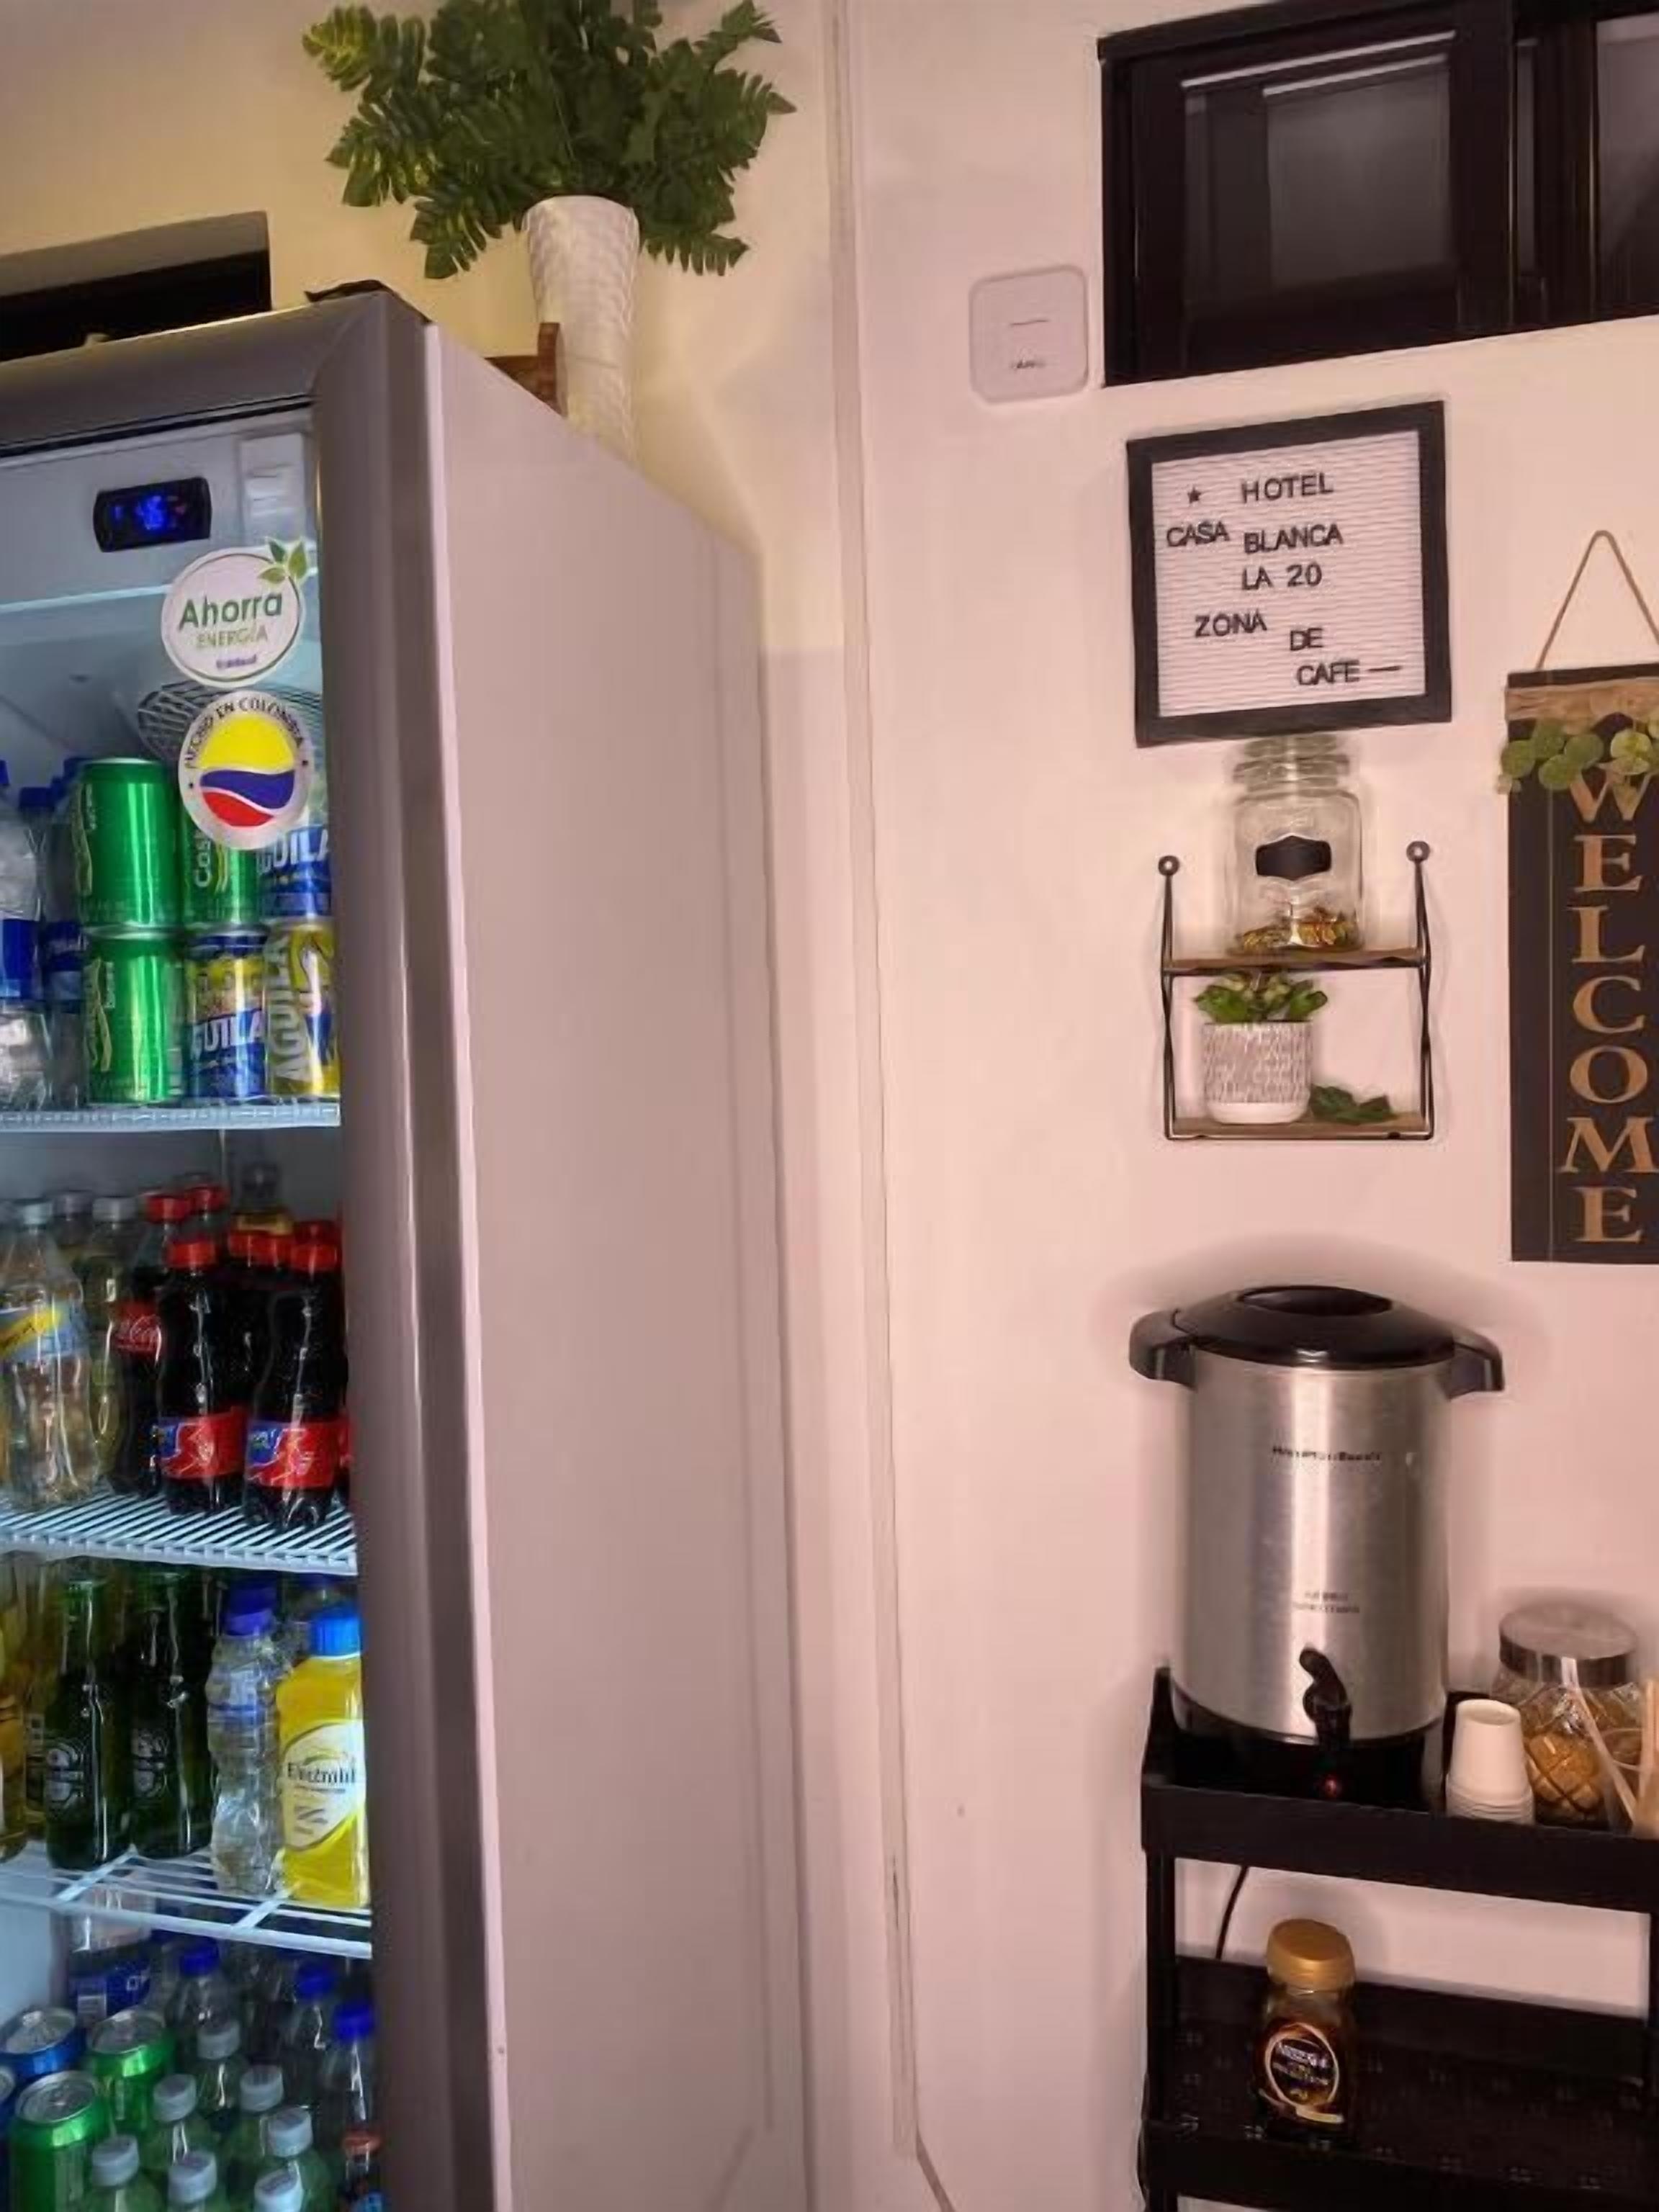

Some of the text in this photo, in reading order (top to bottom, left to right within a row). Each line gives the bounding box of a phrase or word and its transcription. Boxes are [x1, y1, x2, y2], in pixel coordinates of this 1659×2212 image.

[1241, 472, 1334, 503] HOTEL
[1166, 521, 1344, 554] CASA BLANCA
[1241, 562, 1323, 590] LA 20
[178, 593, 282, 631] Ahorra
[1195, 608, 1324, 651] ZONA DE
[1297, 659, 1360, 685] CAFE
[1557, 761, 1659, 1243] WELCOME
